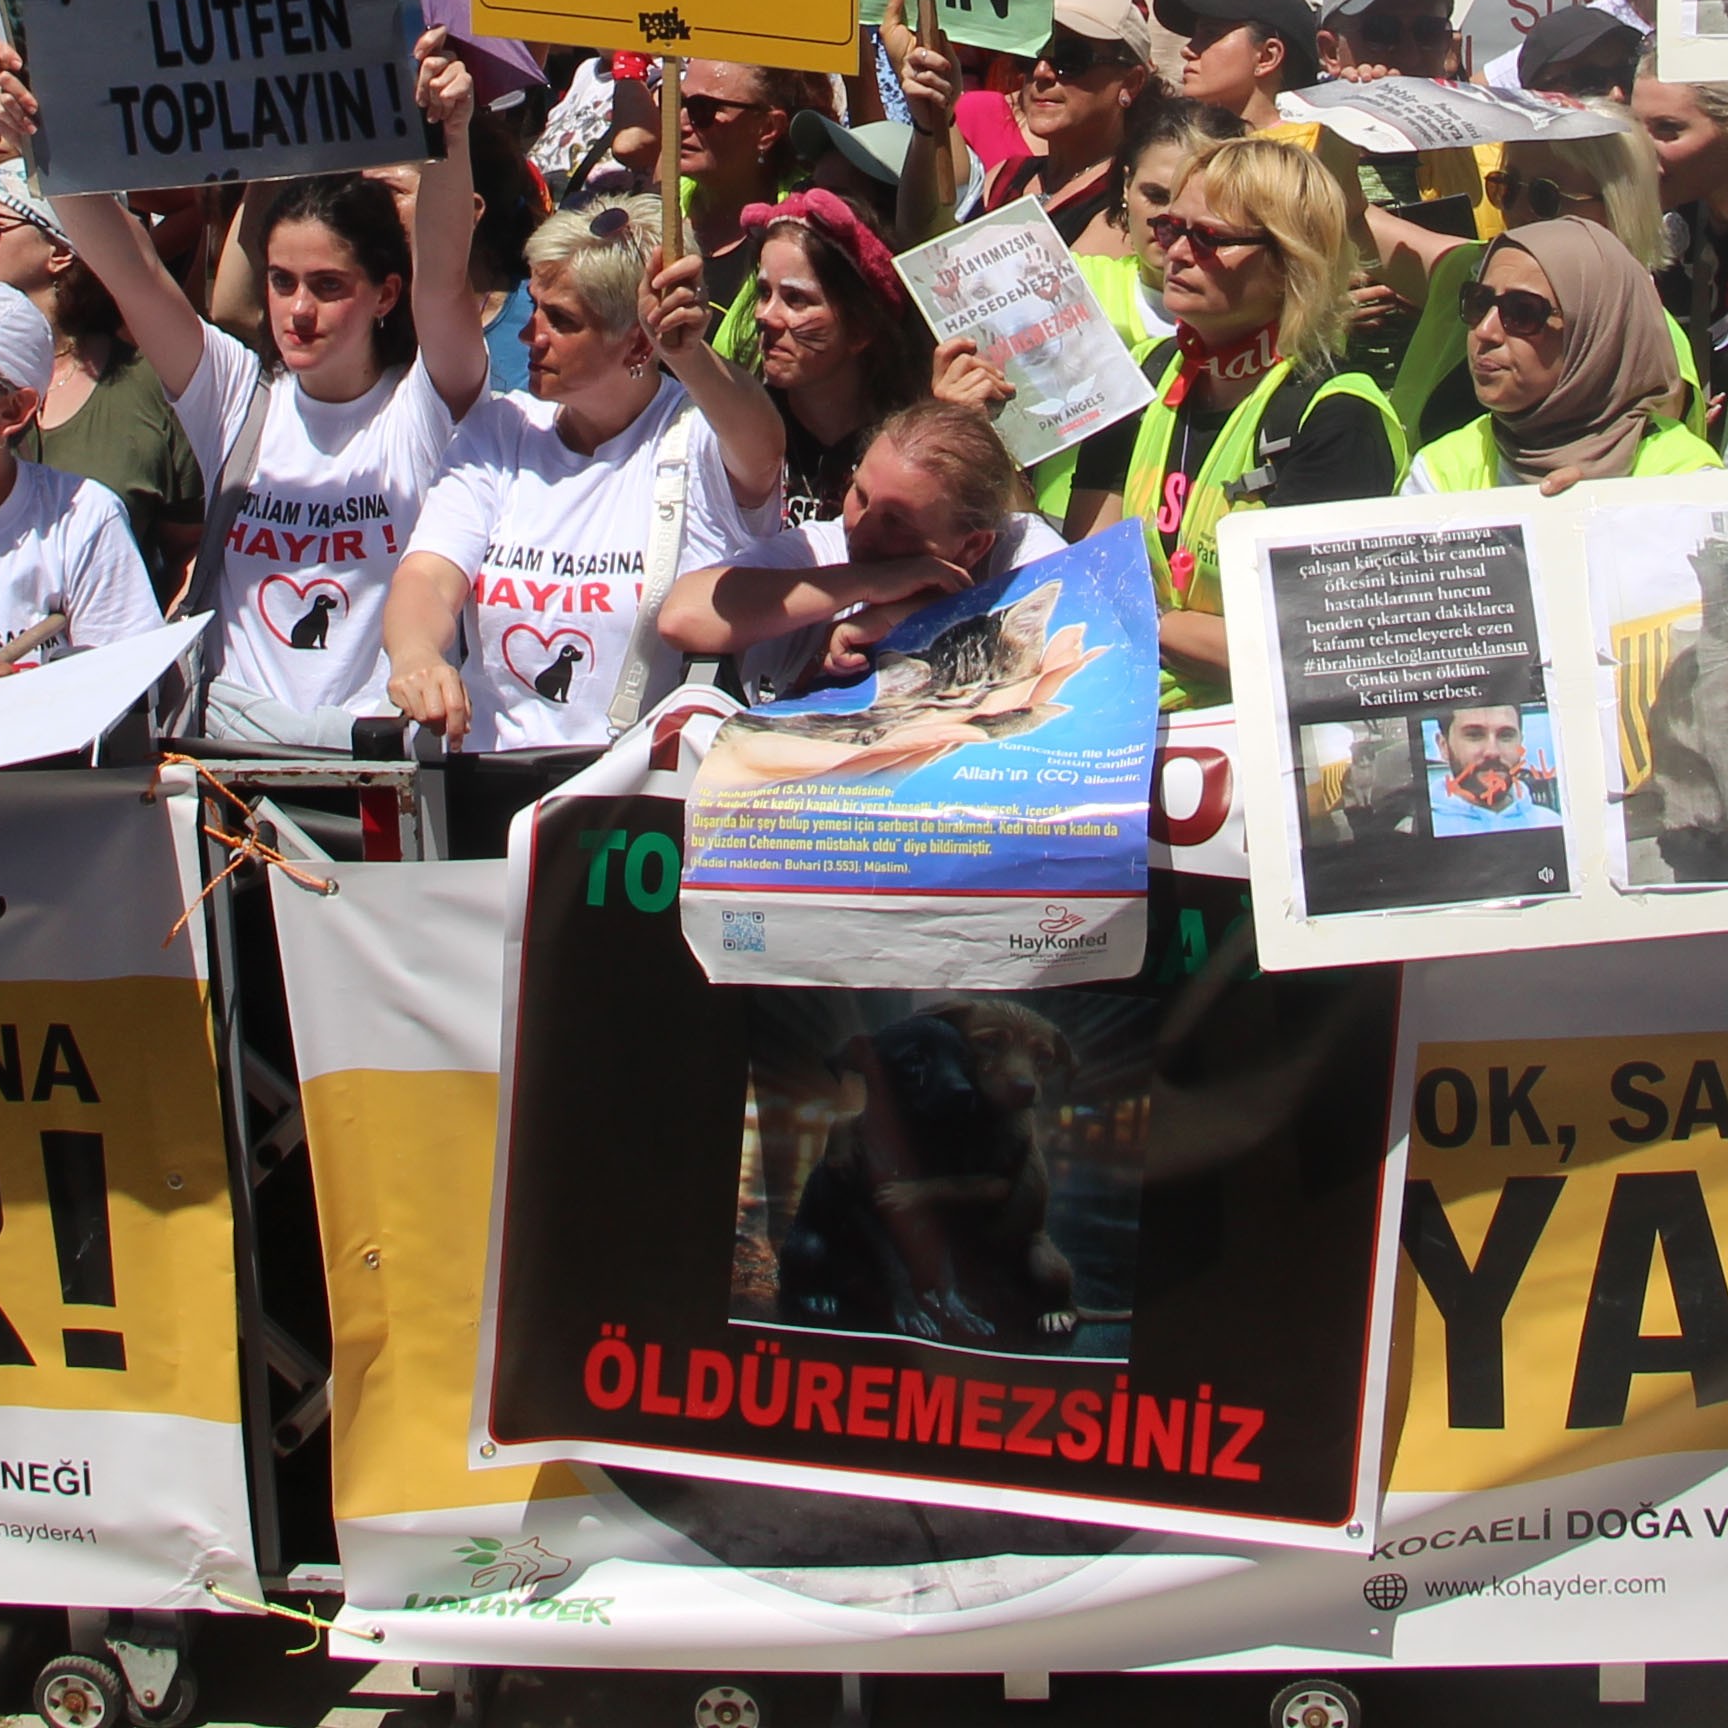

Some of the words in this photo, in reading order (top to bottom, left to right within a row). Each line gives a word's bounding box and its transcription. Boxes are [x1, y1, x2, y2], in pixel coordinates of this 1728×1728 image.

[110, 69, 377, 156] TOPLAYIN
[385, 62, 408, 137] !
[582, 1323, 1265, 1482] ÖLDÜREMEZSİNİZ
